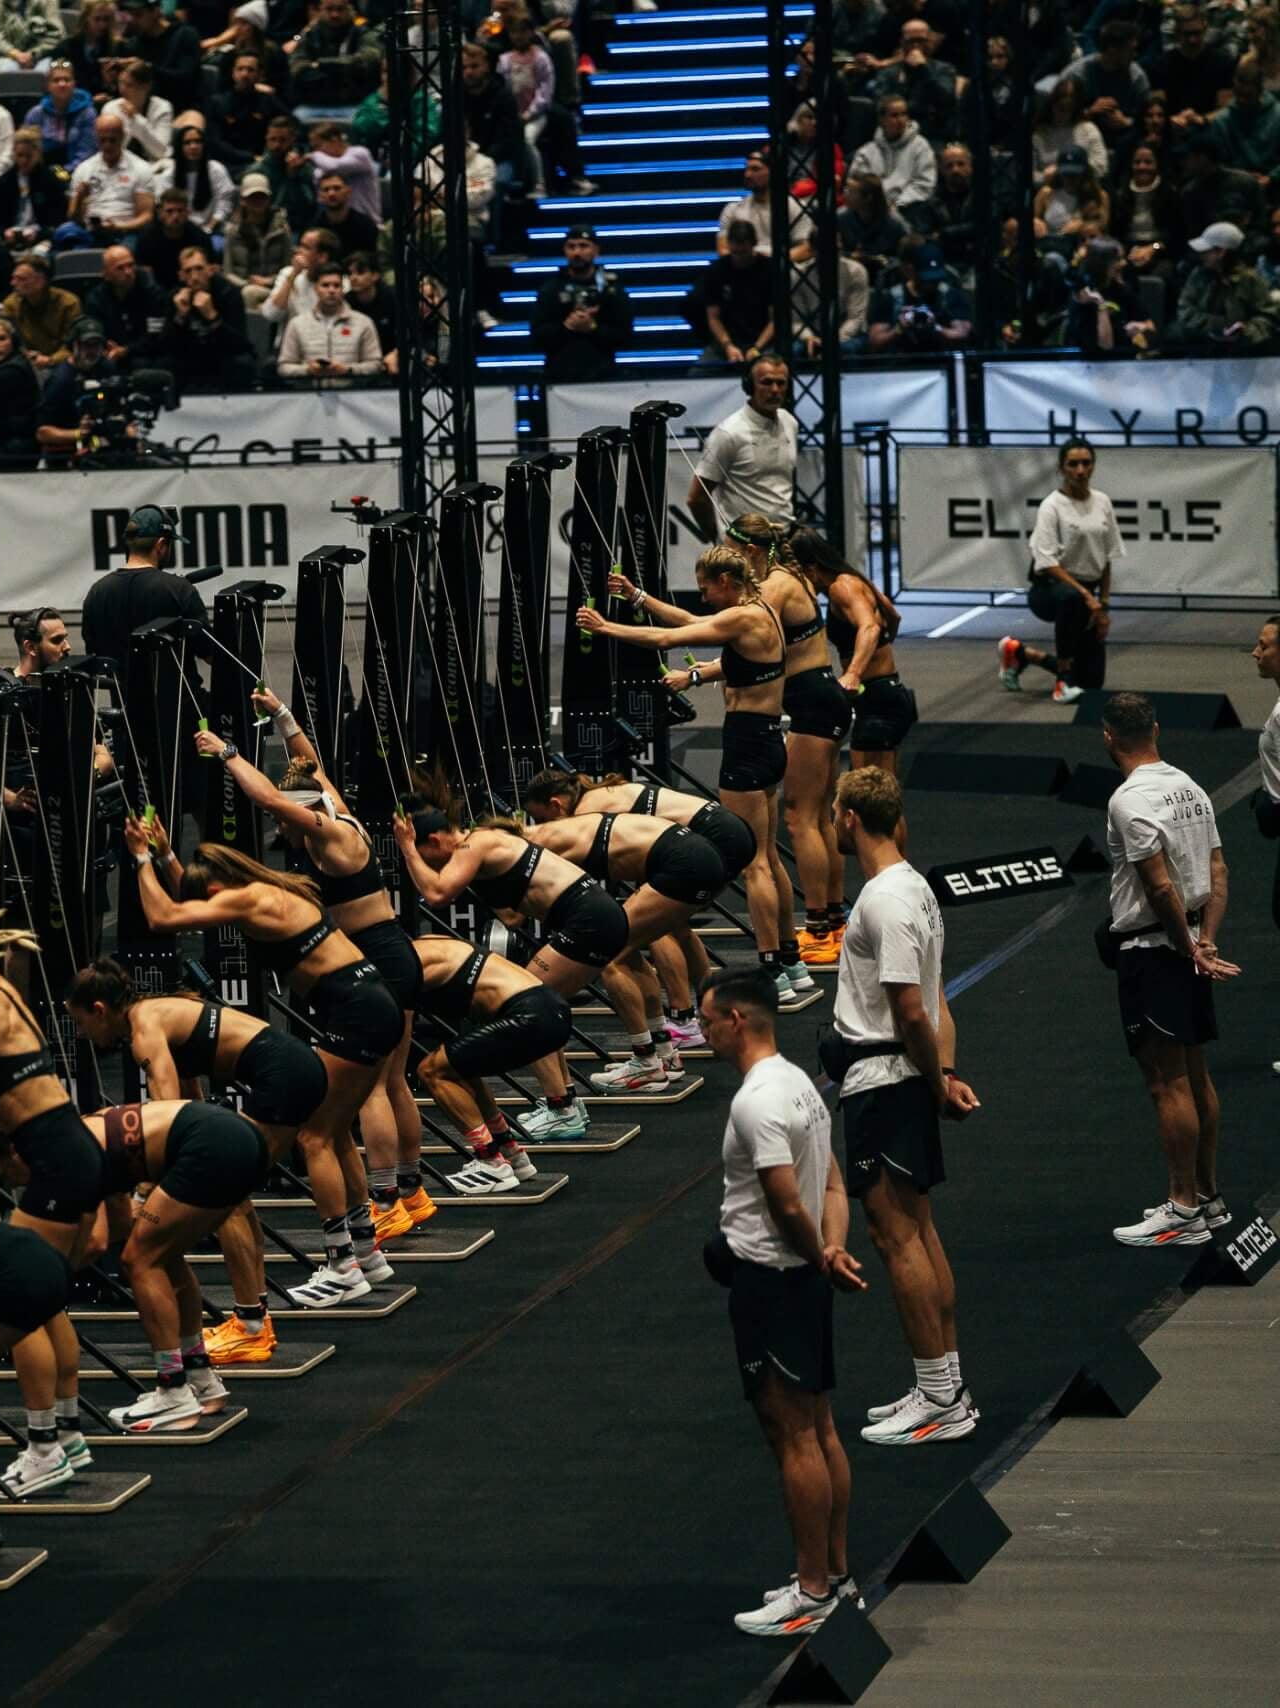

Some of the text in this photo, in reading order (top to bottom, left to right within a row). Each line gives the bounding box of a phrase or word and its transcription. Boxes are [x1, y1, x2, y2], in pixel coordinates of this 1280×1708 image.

[92, 503, 288, 569] PMA
[949, 500, 1220, 541] ELE15
[944, 856, 1063, 896] ELITE15
[1226, 1216, 1277, 1271] ELITE15
